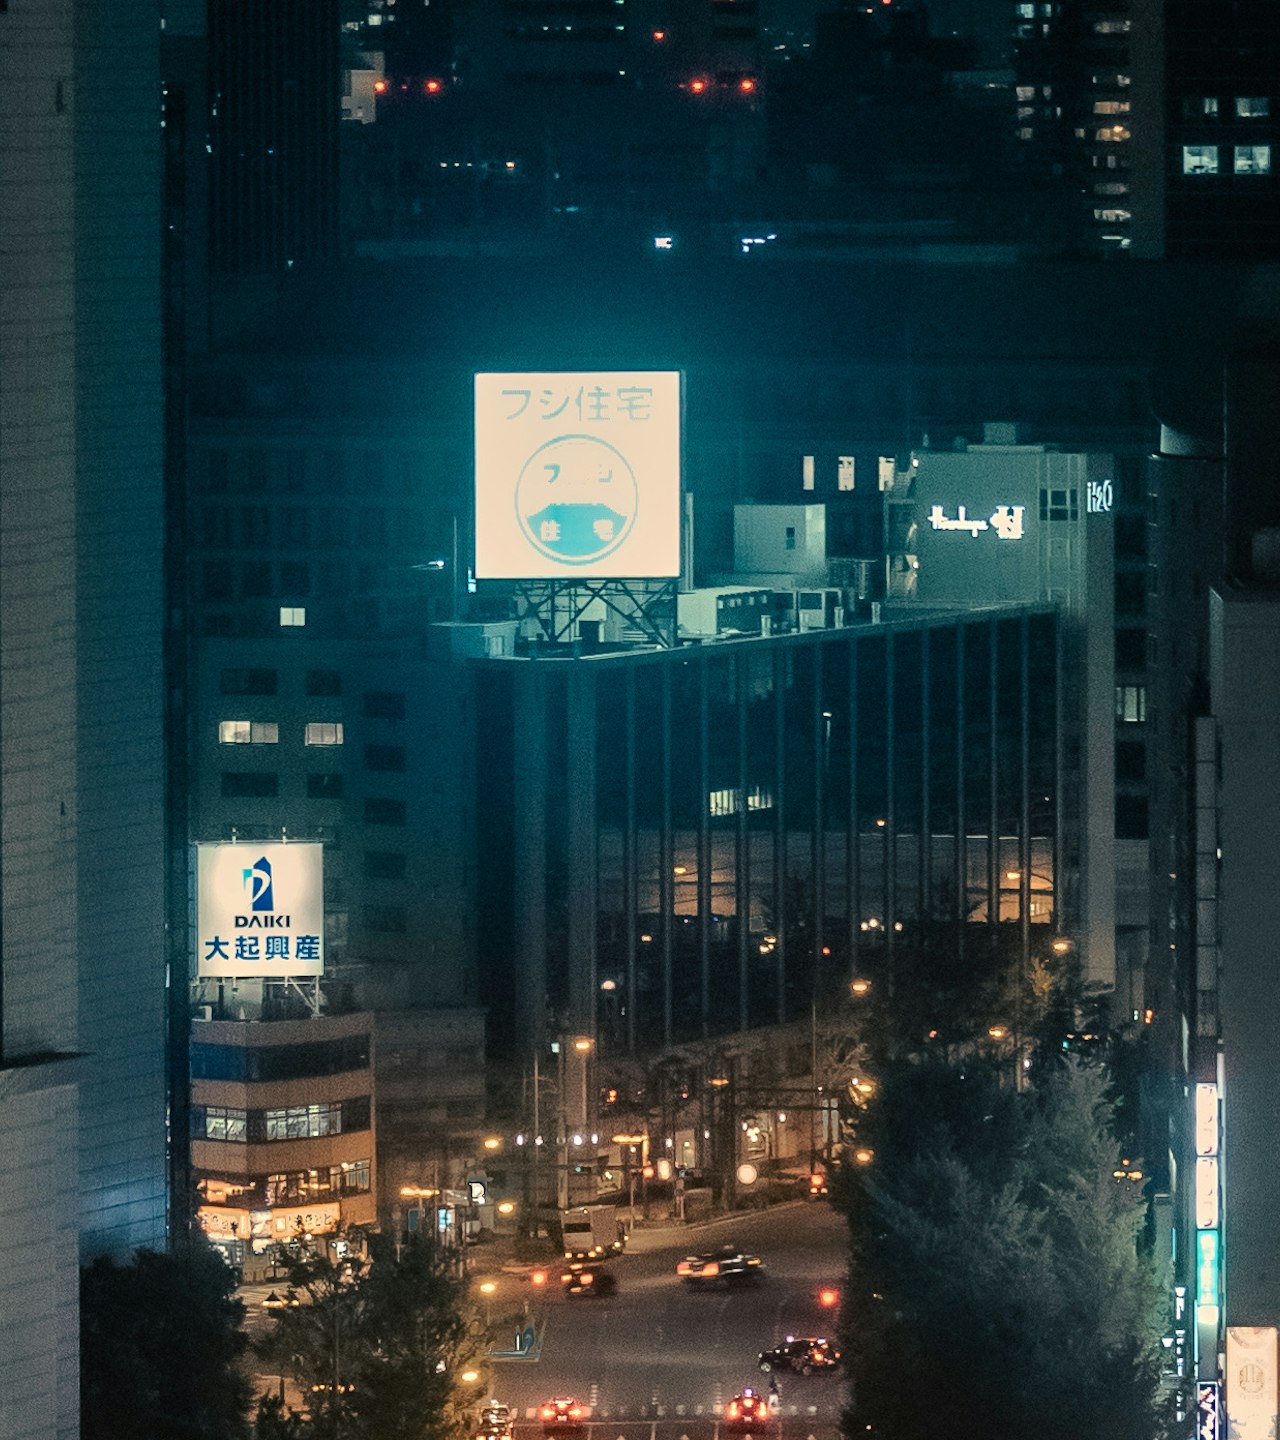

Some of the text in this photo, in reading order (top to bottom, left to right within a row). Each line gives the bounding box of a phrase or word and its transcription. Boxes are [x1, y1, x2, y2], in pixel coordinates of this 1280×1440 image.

[234, 915, 291, 928] DAIKI
[204, 934, 320, 961] 大起興産
